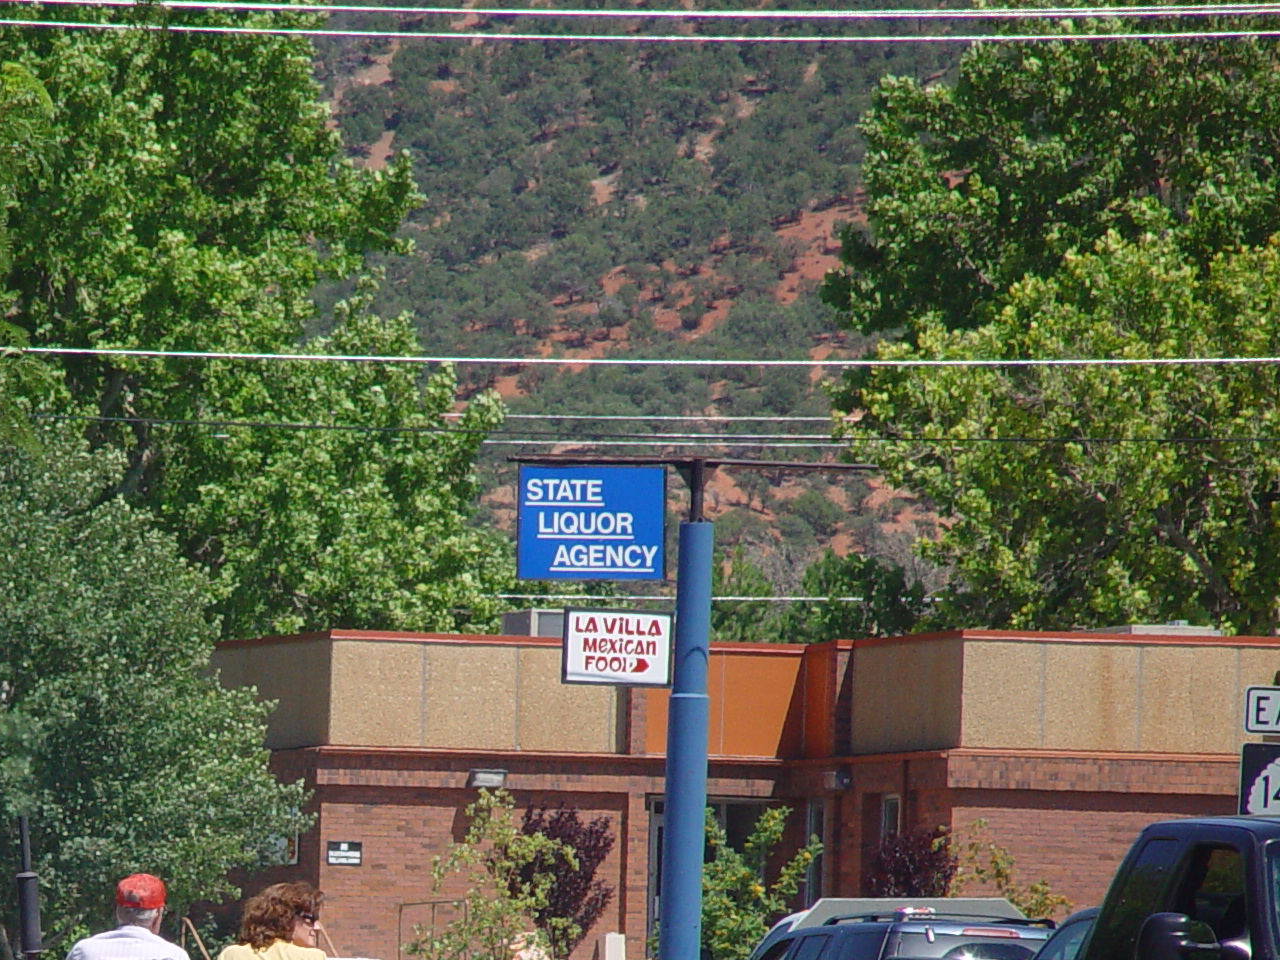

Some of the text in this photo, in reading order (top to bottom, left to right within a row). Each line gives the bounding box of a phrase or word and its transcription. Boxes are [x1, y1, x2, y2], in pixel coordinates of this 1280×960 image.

[526, 478, 603, 501] STATE
[538, 511, 634, 534] LIQUOR
[552, 544, 659, 568] AGENCY
[575, 616, 599, 633] LA
